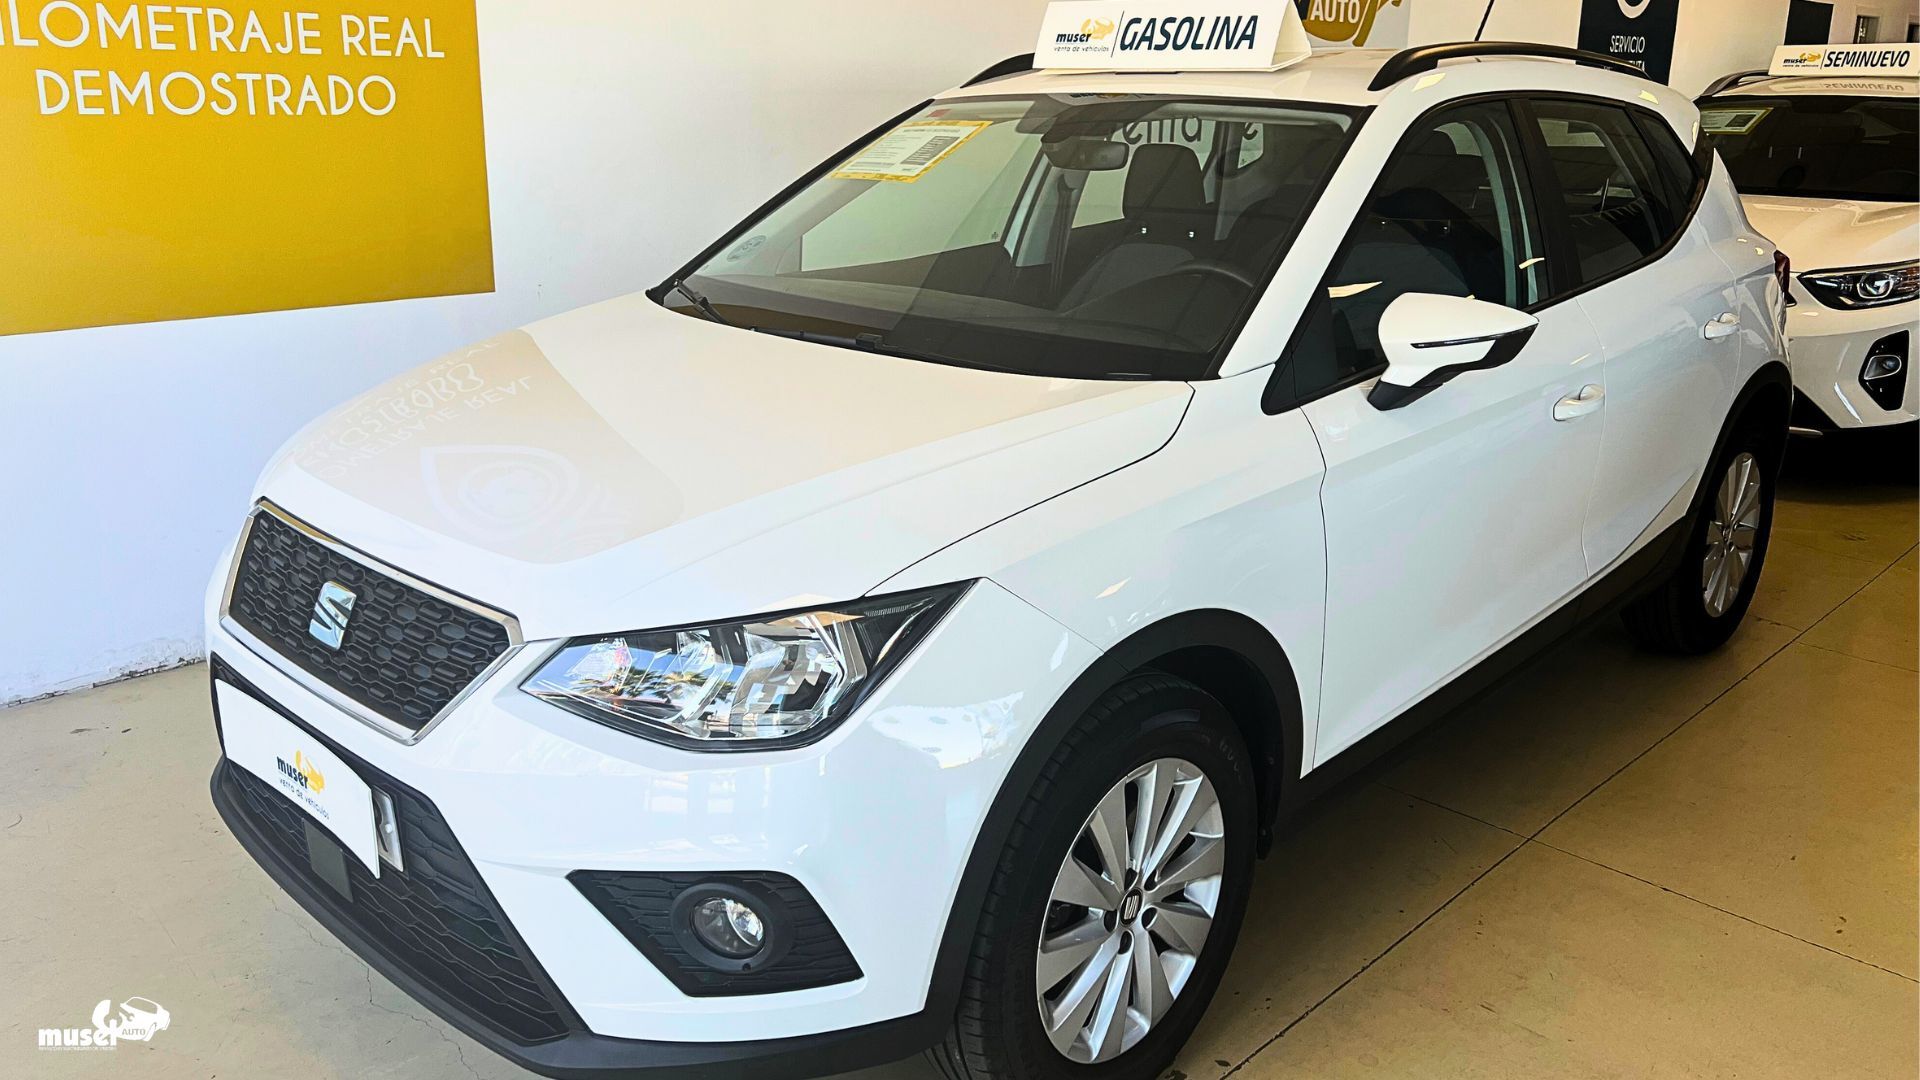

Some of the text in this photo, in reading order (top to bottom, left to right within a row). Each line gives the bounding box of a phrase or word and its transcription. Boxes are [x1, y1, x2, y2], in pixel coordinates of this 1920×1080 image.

[1310, 0, 1361, 24] AUTO
[340, 14, 445, 59] REAL
[1055, 15, 1259, 51] muser GASOLINA
[1609, 34, 1646, 54] SERVICIO
[1824, 50, 1911, 68] SEMINUEVO
[34, 68, 397, 116] DEMOSTRADO
[276, 756, 309, 789] muser
